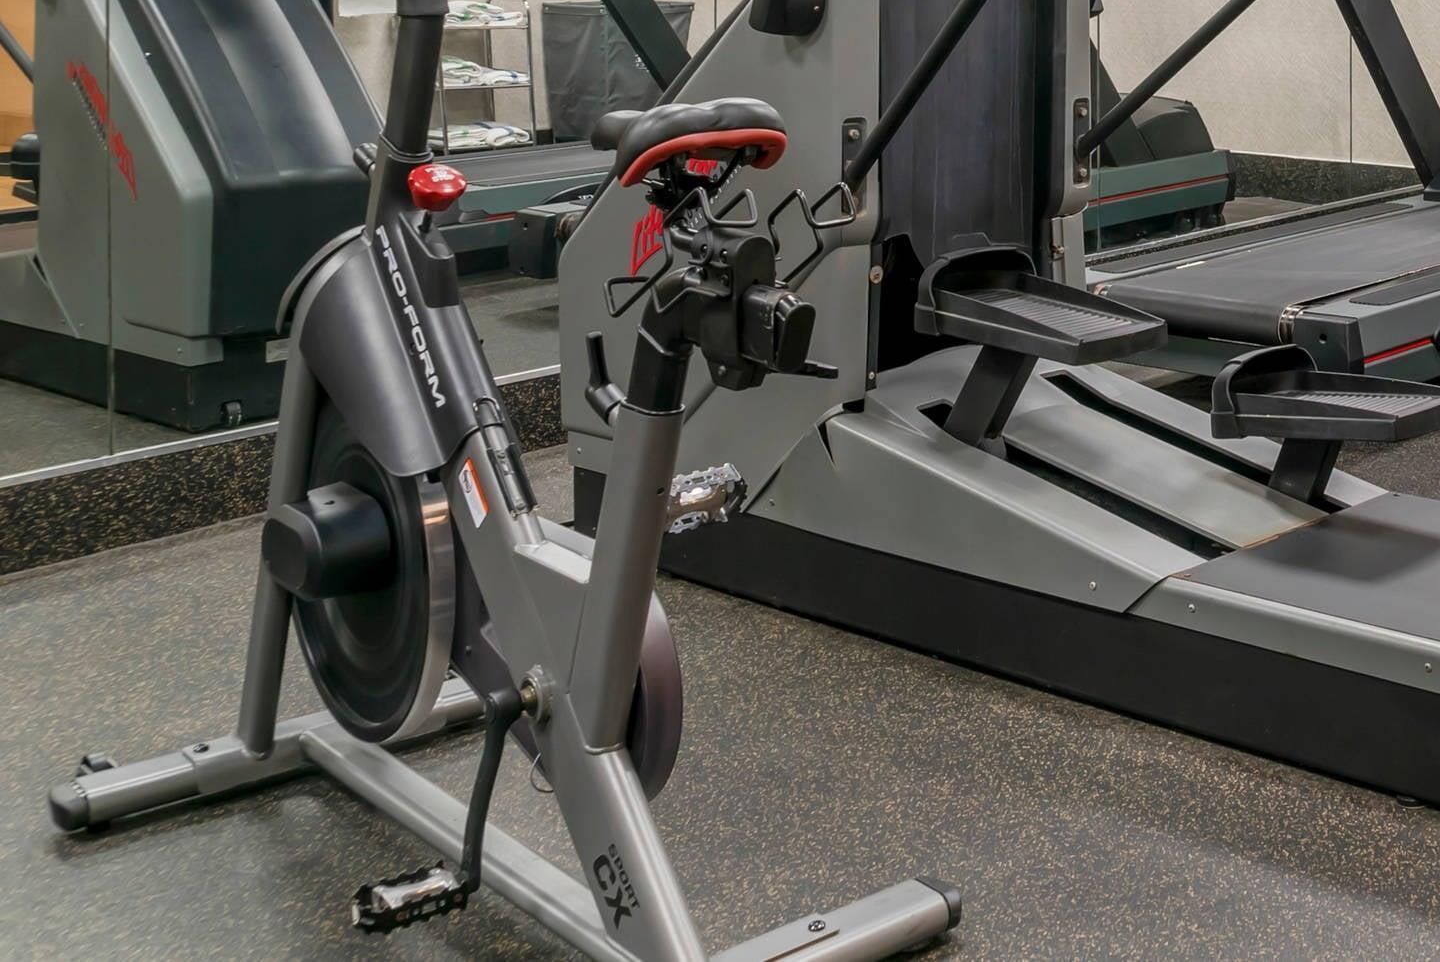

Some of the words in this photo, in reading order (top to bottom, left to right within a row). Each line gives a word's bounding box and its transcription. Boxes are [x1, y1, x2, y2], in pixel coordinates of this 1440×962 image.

[376, 224, 446, 408] PRO-FORM
[593, 854, 632, 930] CX
[608, 843, 640, 910] SPORT
